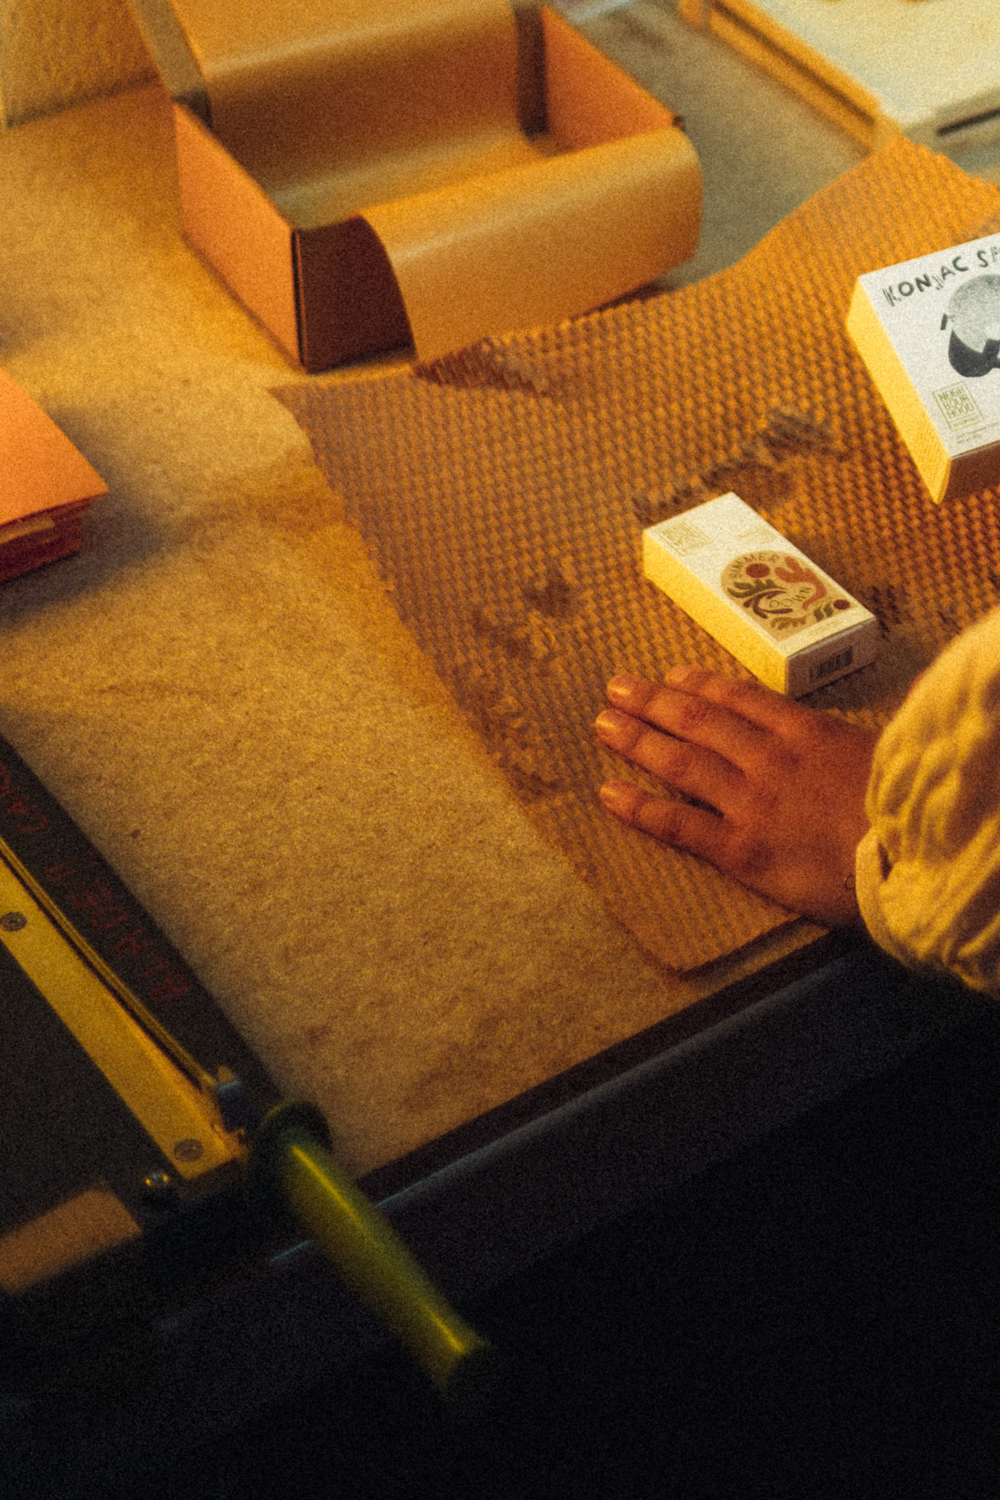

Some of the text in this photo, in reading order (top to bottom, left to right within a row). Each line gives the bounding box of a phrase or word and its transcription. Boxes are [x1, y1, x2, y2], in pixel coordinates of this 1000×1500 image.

[881, 255, 969, 307] KONJAC
[938, 385, 965, 402] NEIGH
[942, 393, 970, 411] BOUR
[946, 402, 975, 419] HOOD
[769, 586, 812, 609] DOWN
